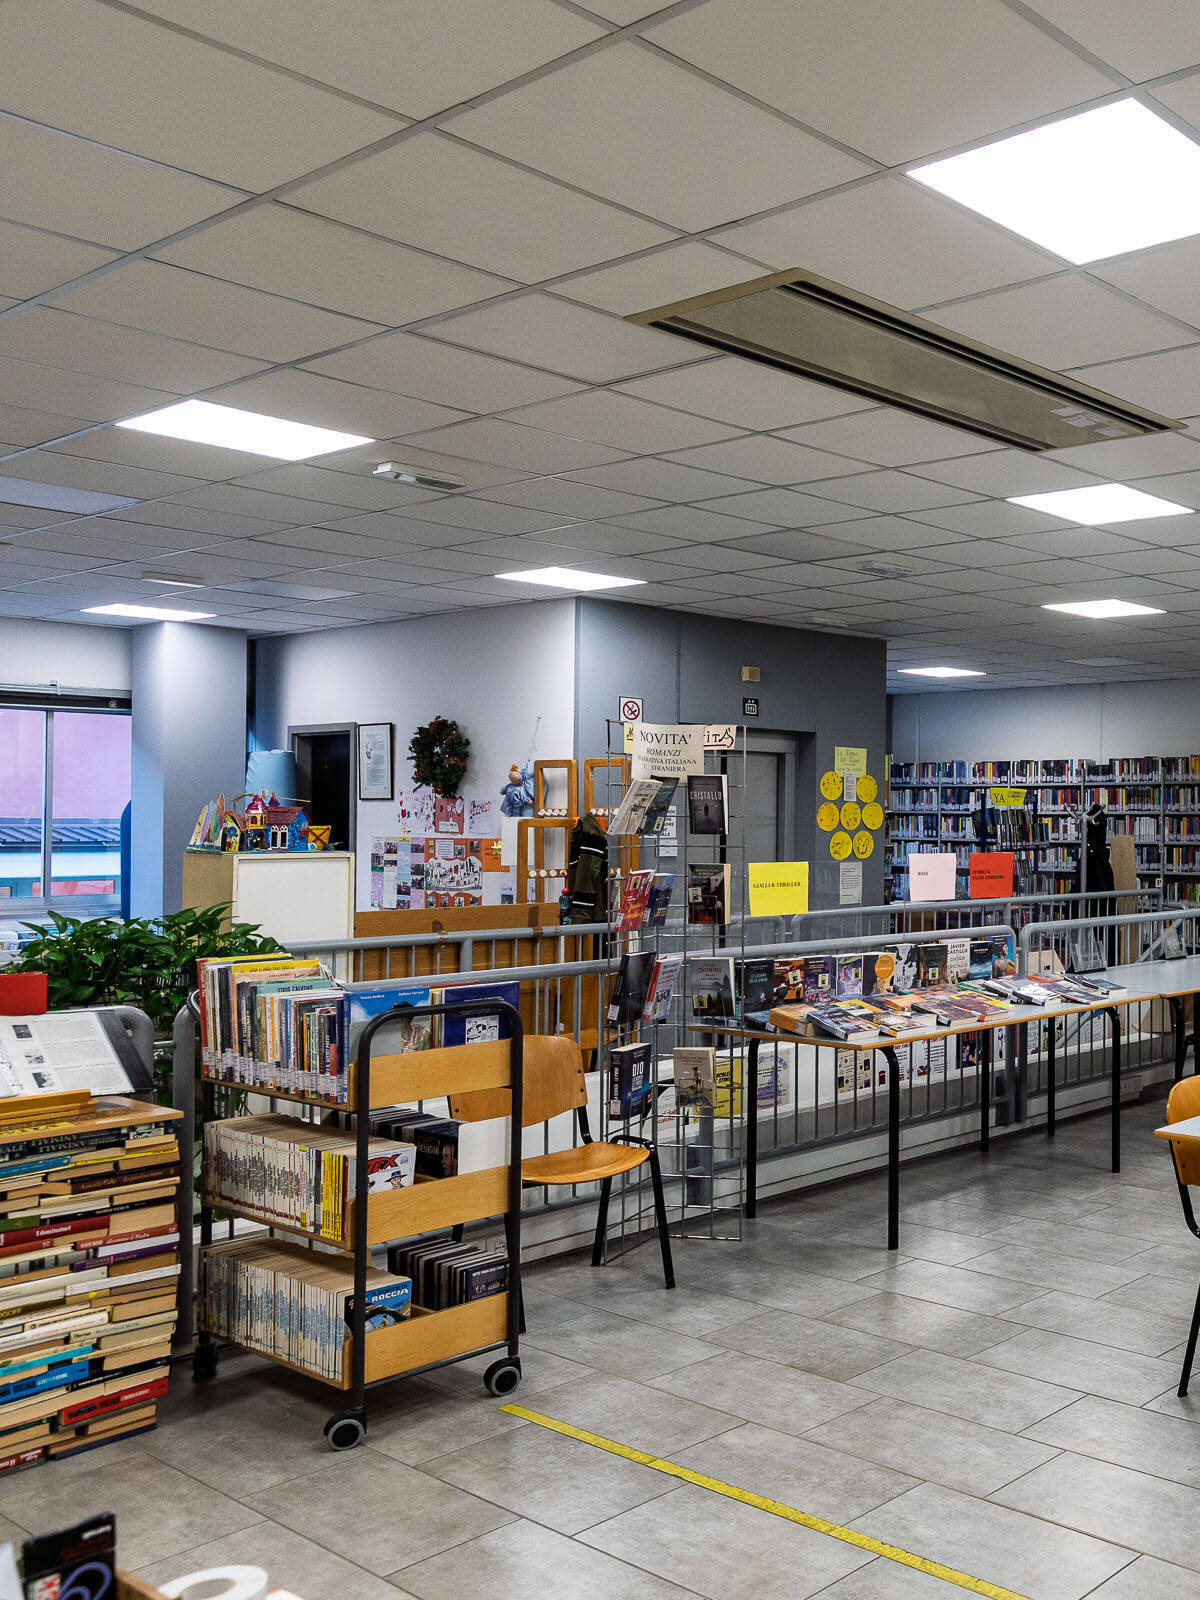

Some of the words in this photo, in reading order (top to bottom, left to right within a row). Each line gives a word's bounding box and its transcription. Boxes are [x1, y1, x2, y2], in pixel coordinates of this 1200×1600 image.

[640, 731, 691, 745] NOVITA'
[647, 748, 682, 757] ROMANZI
[690, 791, 723, 800] CRISTALLO
[993, 792, 1005, 803] YA
[368, 1153, 402, 1176] TEX
[372, 1288, 409, 1303] ROCCIA
